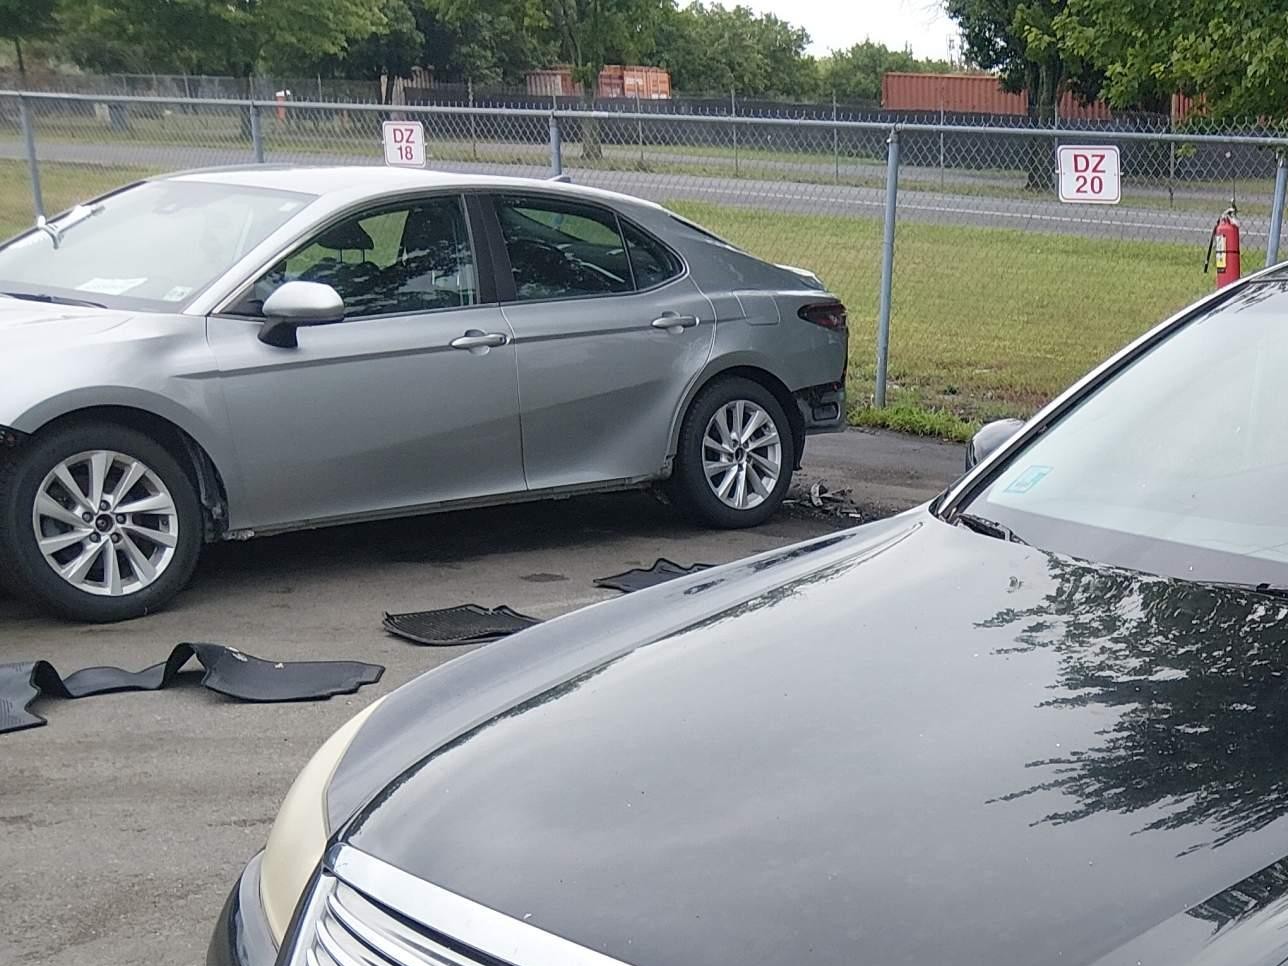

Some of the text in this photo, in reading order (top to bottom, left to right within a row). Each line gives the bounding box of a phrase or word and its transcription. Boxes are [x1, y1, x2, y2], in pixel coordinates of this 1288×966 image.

[392, 128, 415, 144] DZ
[397, 145, 413, 160] 18
[1073, 154, 1106, 173] DZ
[1075, 175, 1103, 194] 20
